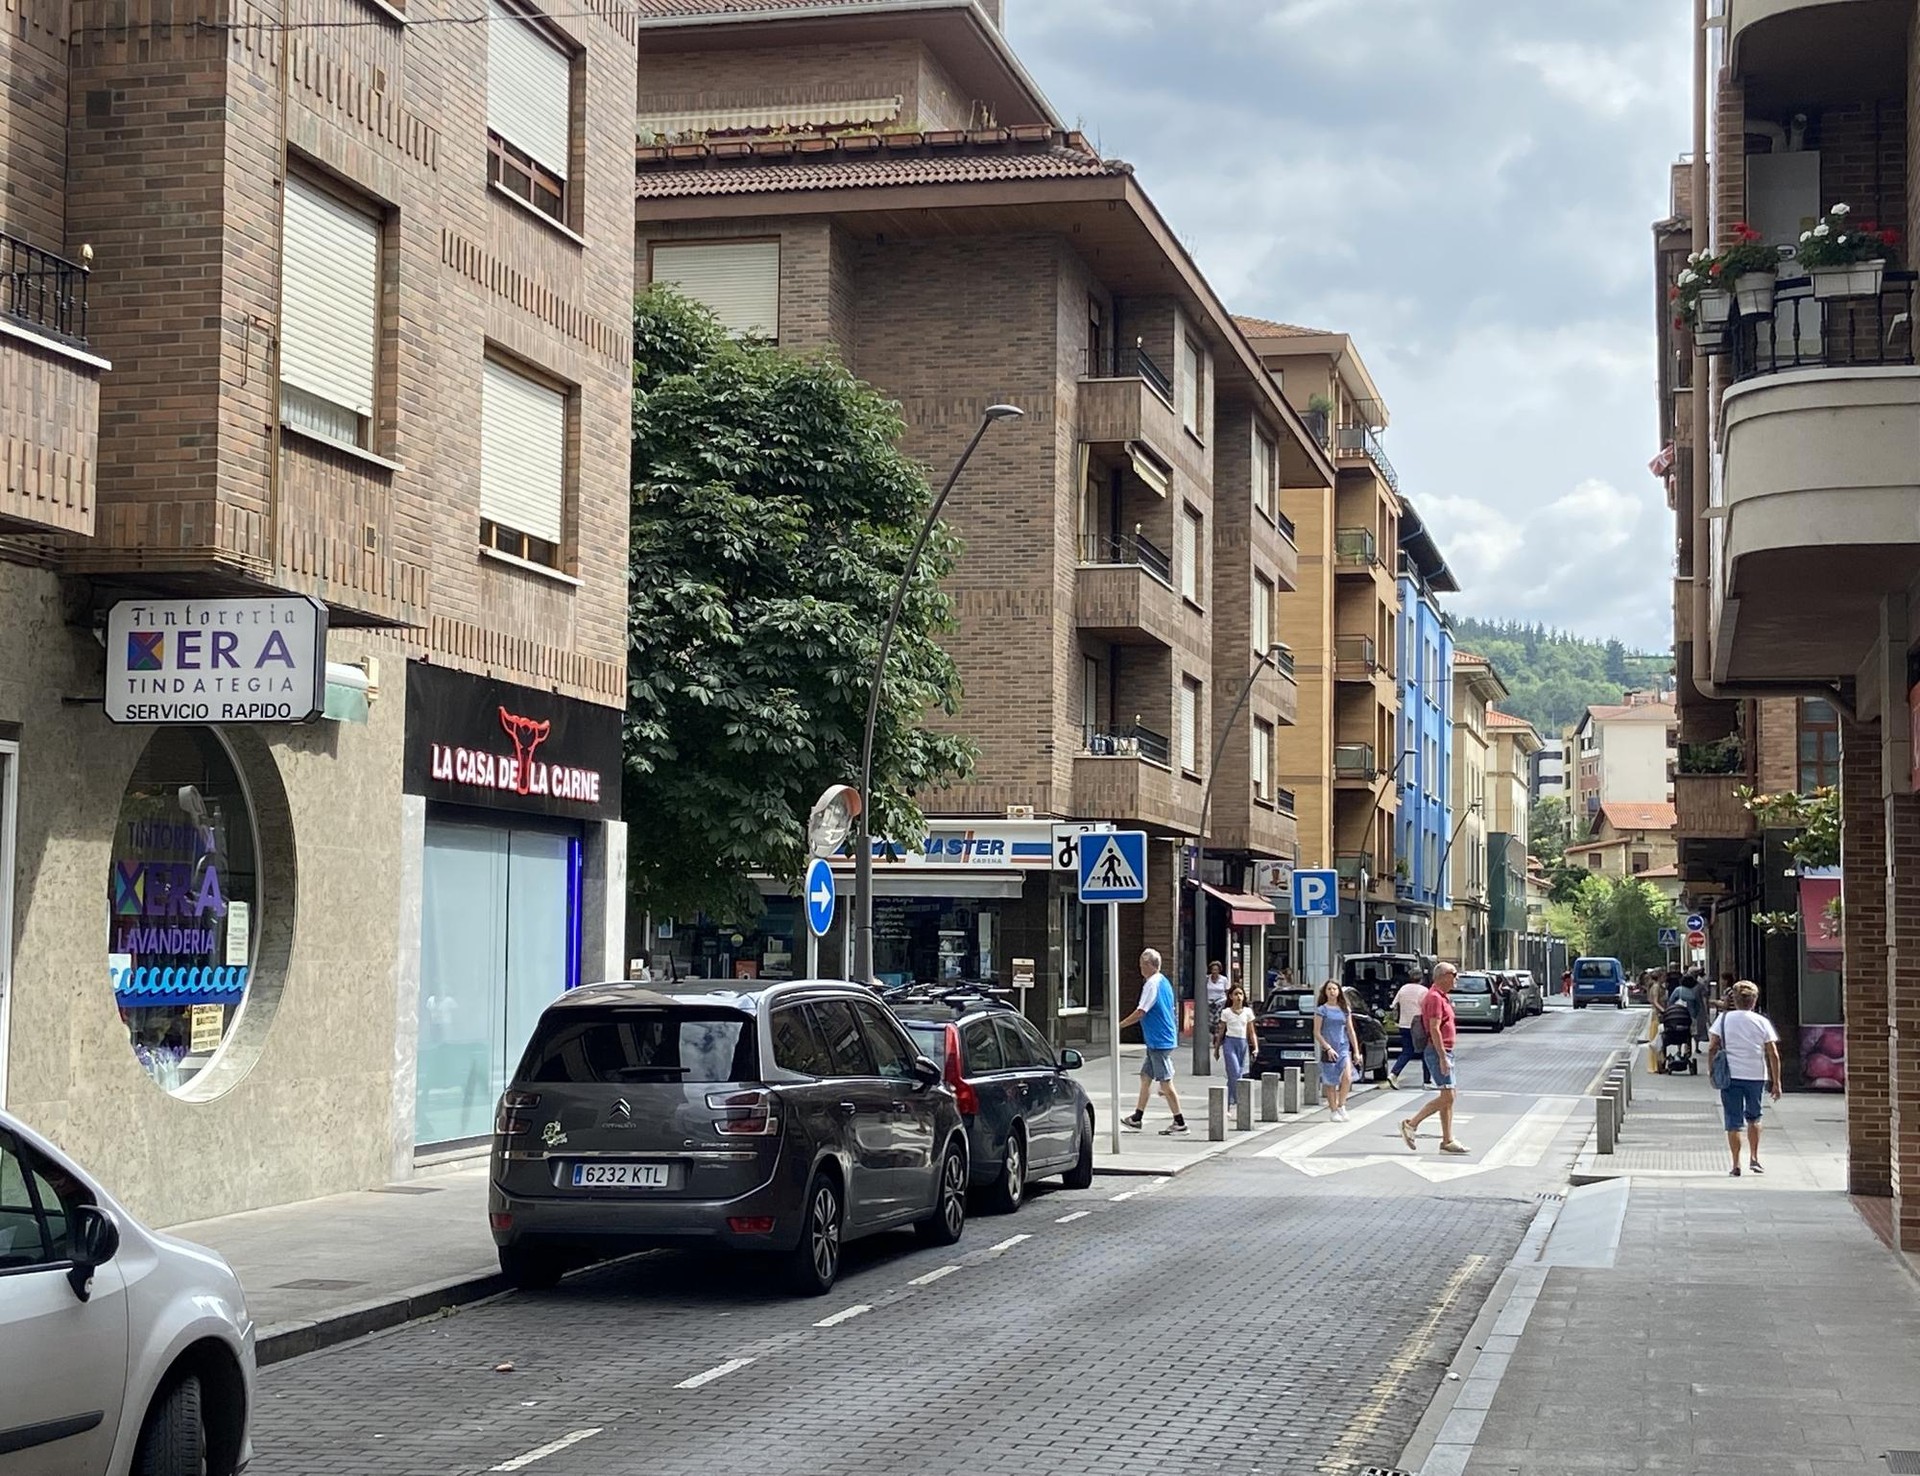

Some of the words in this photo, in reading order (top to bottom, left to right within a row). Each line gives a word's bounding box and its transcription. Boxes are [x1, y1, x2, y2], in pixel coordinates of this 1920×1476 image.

[131, 603, 295, 626] Tintoreria
[128, 677, 294, 694] TINDATEGIA
[126, 704, 209, 720] SERVICIO
[222, 703, 291, 719] RAPIDO
[432, 743, 453, 780] LA
[455, 747, 495, 787] CASA
[499, 755, 518, 791] DE
[529, 761, 548, 795] LA
[551, 764, 600, 802] CARNE
[1301, 877, 1327, 911] P
[116, 927, 216, 955] LAVANDERIA
[586, 1167, 626, 1183] 6232
[632, 1166, 662, 1183] KTL
